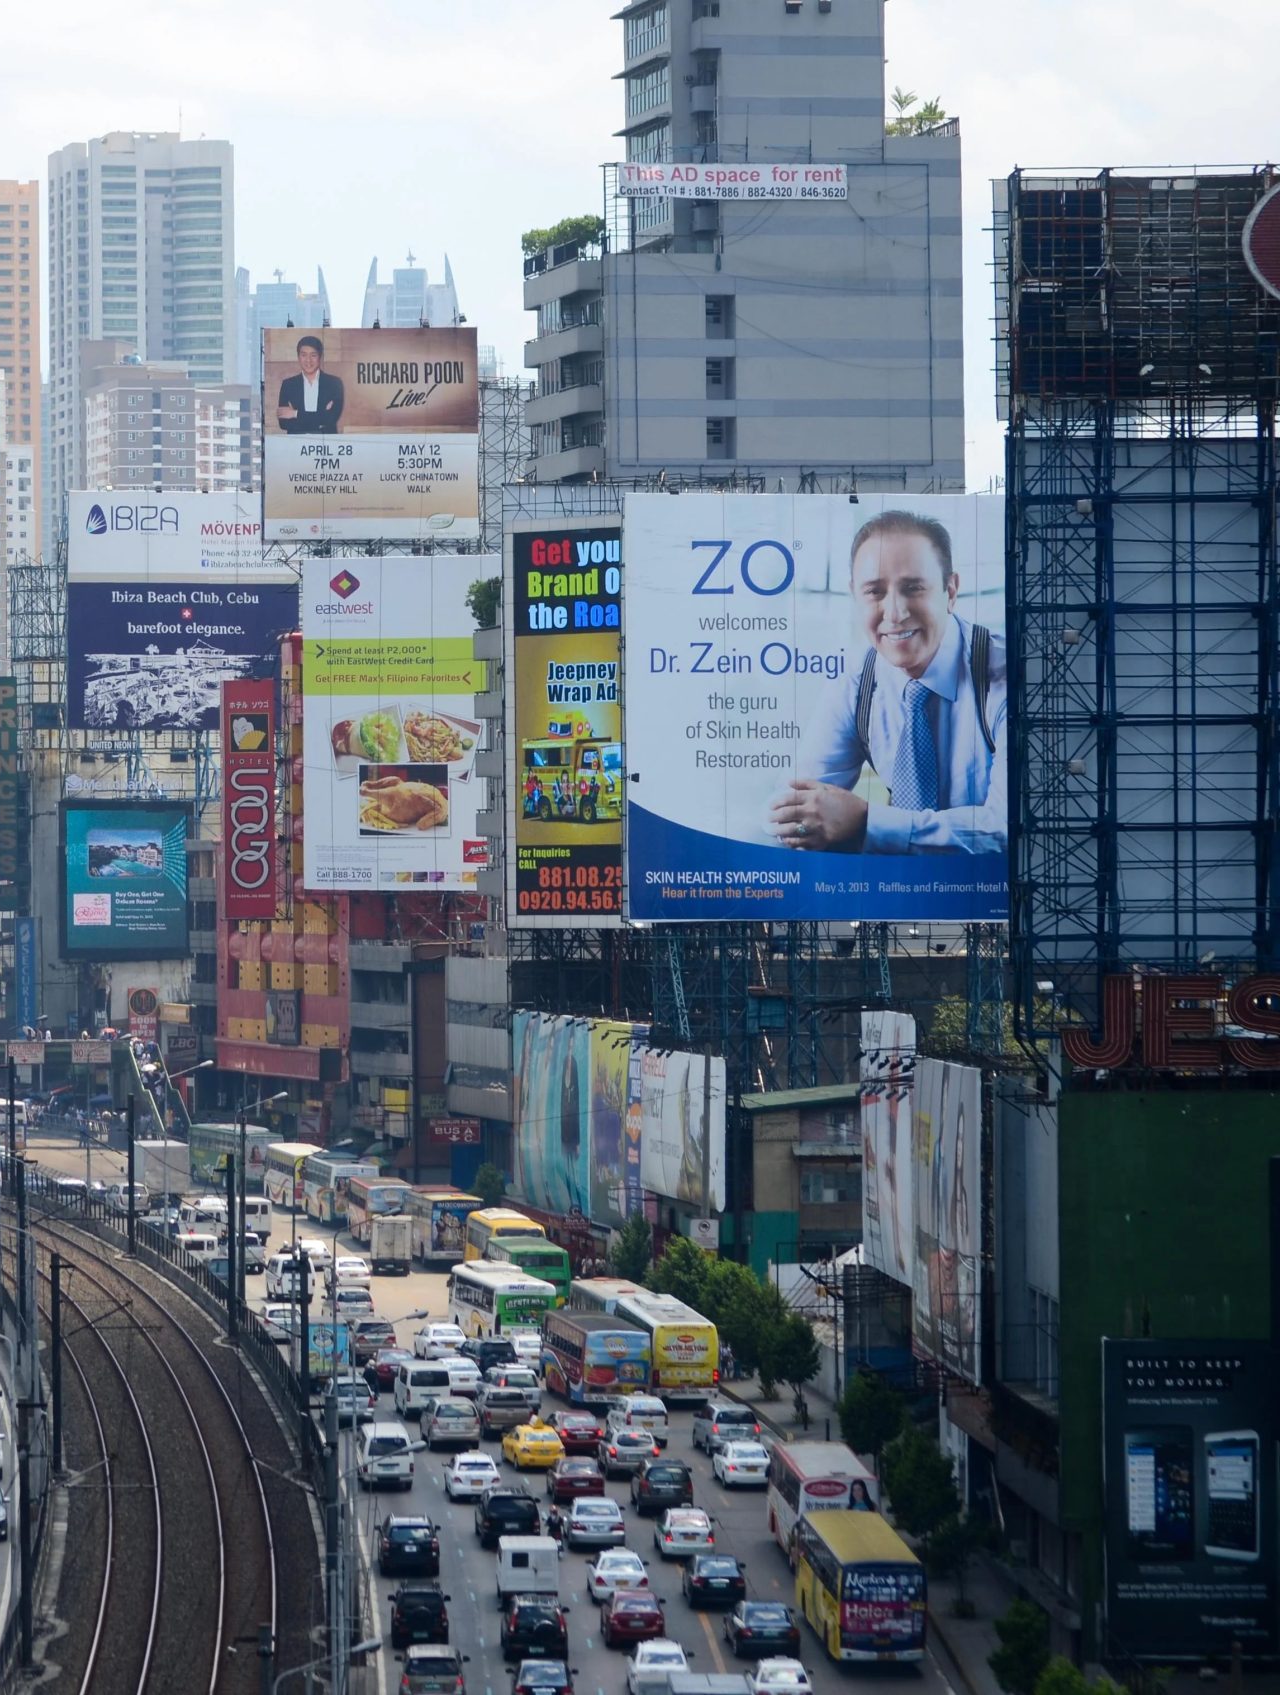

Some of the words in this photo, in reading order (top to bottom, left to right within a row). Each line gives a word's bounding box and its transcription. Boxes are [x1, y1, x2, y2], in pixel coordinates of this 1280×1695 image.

[623, 166, 665, 182] This
[671, 166, 698, 182] AD
[705, 169, 760, 185] space
[772, 166, 798, 182] for
[804, 168, 842, 182] rent
[620, 186, 661, 196] Contact
[663, 186, 677, 196] Tel
[694, 187, 739, 198] 881-7886
[748, 187, 792, 198] 882-4320
[800, 187, 846, 198] 846-3620
[357, 362, 419, 384] RICHARD
[424, 361, 464, 384] POON
[386, 384, 437, 410] Live!
[300, 445, 333, 456] APRIL
[338, 445, 353, 456] 28
[398, 444, 426, 456] MAY
[430, 444, 441, 456] 12
[314, 458, 340, 470] 7PM
[398, 458, 442, 469] 5:30PM
[288, 474, 318, 482] VENICE
[320, 474, 350, 482] PIAZZA
[352, 474, 364, 482] AT
[380, 473, 407, 482] LUCKY
[410, 473, 459, 481] CHINATOWN
[294, 486, 337, 494] MCKINLEY
[340, 486, 358, 494] HILL
[407, 485, 431, 494] WALK
[110, 506, 179, 532] IBIZA
[201, 550, 224, 558] Phone
[226, 550, 240, 558] +63
[242, 550, 252, 558] 32
[532, 538, 572, 566] Get
[576, 540, 620, 567] you
[528, 568, 599, 598] Brand
[111, 591, 143, 604] Ibiza
[147, 591, 187, 604] Beach
[190, 591, 223, 606] Club,
[227, 592, 260, 604] Cebu
[315, 602, 374, 616] eastwest
[528, 602, 568, 630] the
[574, 602, 619, 628] Roa
[698, 614, 788, 632] welcomes
[127, 621, 182, 635] barefoot
[186, 621, 245, 638] elegance.
[326, 646, 352, 656] Spend
[364, 646, 384, 654] least
[326, 657, 345, 665] with
[348, 657, 386, 665] EastWest
[388, 657, 413, 665] Credit
[416, 656, 434, 664] Card
[650, 649, 682, 674] Dr.
[690, 643, 752, 674] Zein
[760, 642, 846, 680] Obagi
[548, 662, 616, 682] Jeepney
[316, 674, 331, 682] Get
[334, 674, 356, 682] FREE
[359, 674, 384, 682] Max's
[387, 674, 418, 684] Filipino
[421, 674, 461, 682] Favorites
[548, 684, 592, 703] Wrap
[596, 682, 617, 701] Ad
[708, 693, 736, 710] the
[740, 697, 778, 714] guru
[686, 721, 704, 740] of
[706, 721, 742, 740] Skin
[747, 721, 801, 740] Health
[696, 750, 792, 768] Restoration
[230, 768, 269, 888] SOGO
[518, 848, 532, 858] For
[533, 848, 570, 858] Inquiries
[518, 860, 536, 870] CALL
[645, 872, 672, 884] SKIN
[677, 872, 722, 884] HEALTH
[724, 872, 801, 884] SYMPOSIUM
[662, 887, 687, 898] Hear
[698, 887, 722, 898] from
[725, 887, 742, 898] the
[744, 887, 784, 900] Experts
[814, 882, 836, 896] May
[838, 882, 846, 895] 3,
[848, 882, 870, 893] 2013
[878, 882, 911, 893] Raffles
[914, 882, 932, 893] and
[934, 882, 974, 893] Fairmont
[977, 882, 1000, 893] Hotel
[170, 1039, 194, 1048] LBC
[1127, 1360, 1169, 1368] BUILT
[1178, 1360, 1196, 1368] TO
[1206, 1360, 1242, 1368] KEEP
[1127, 1378, 1156, 1387] YOU
